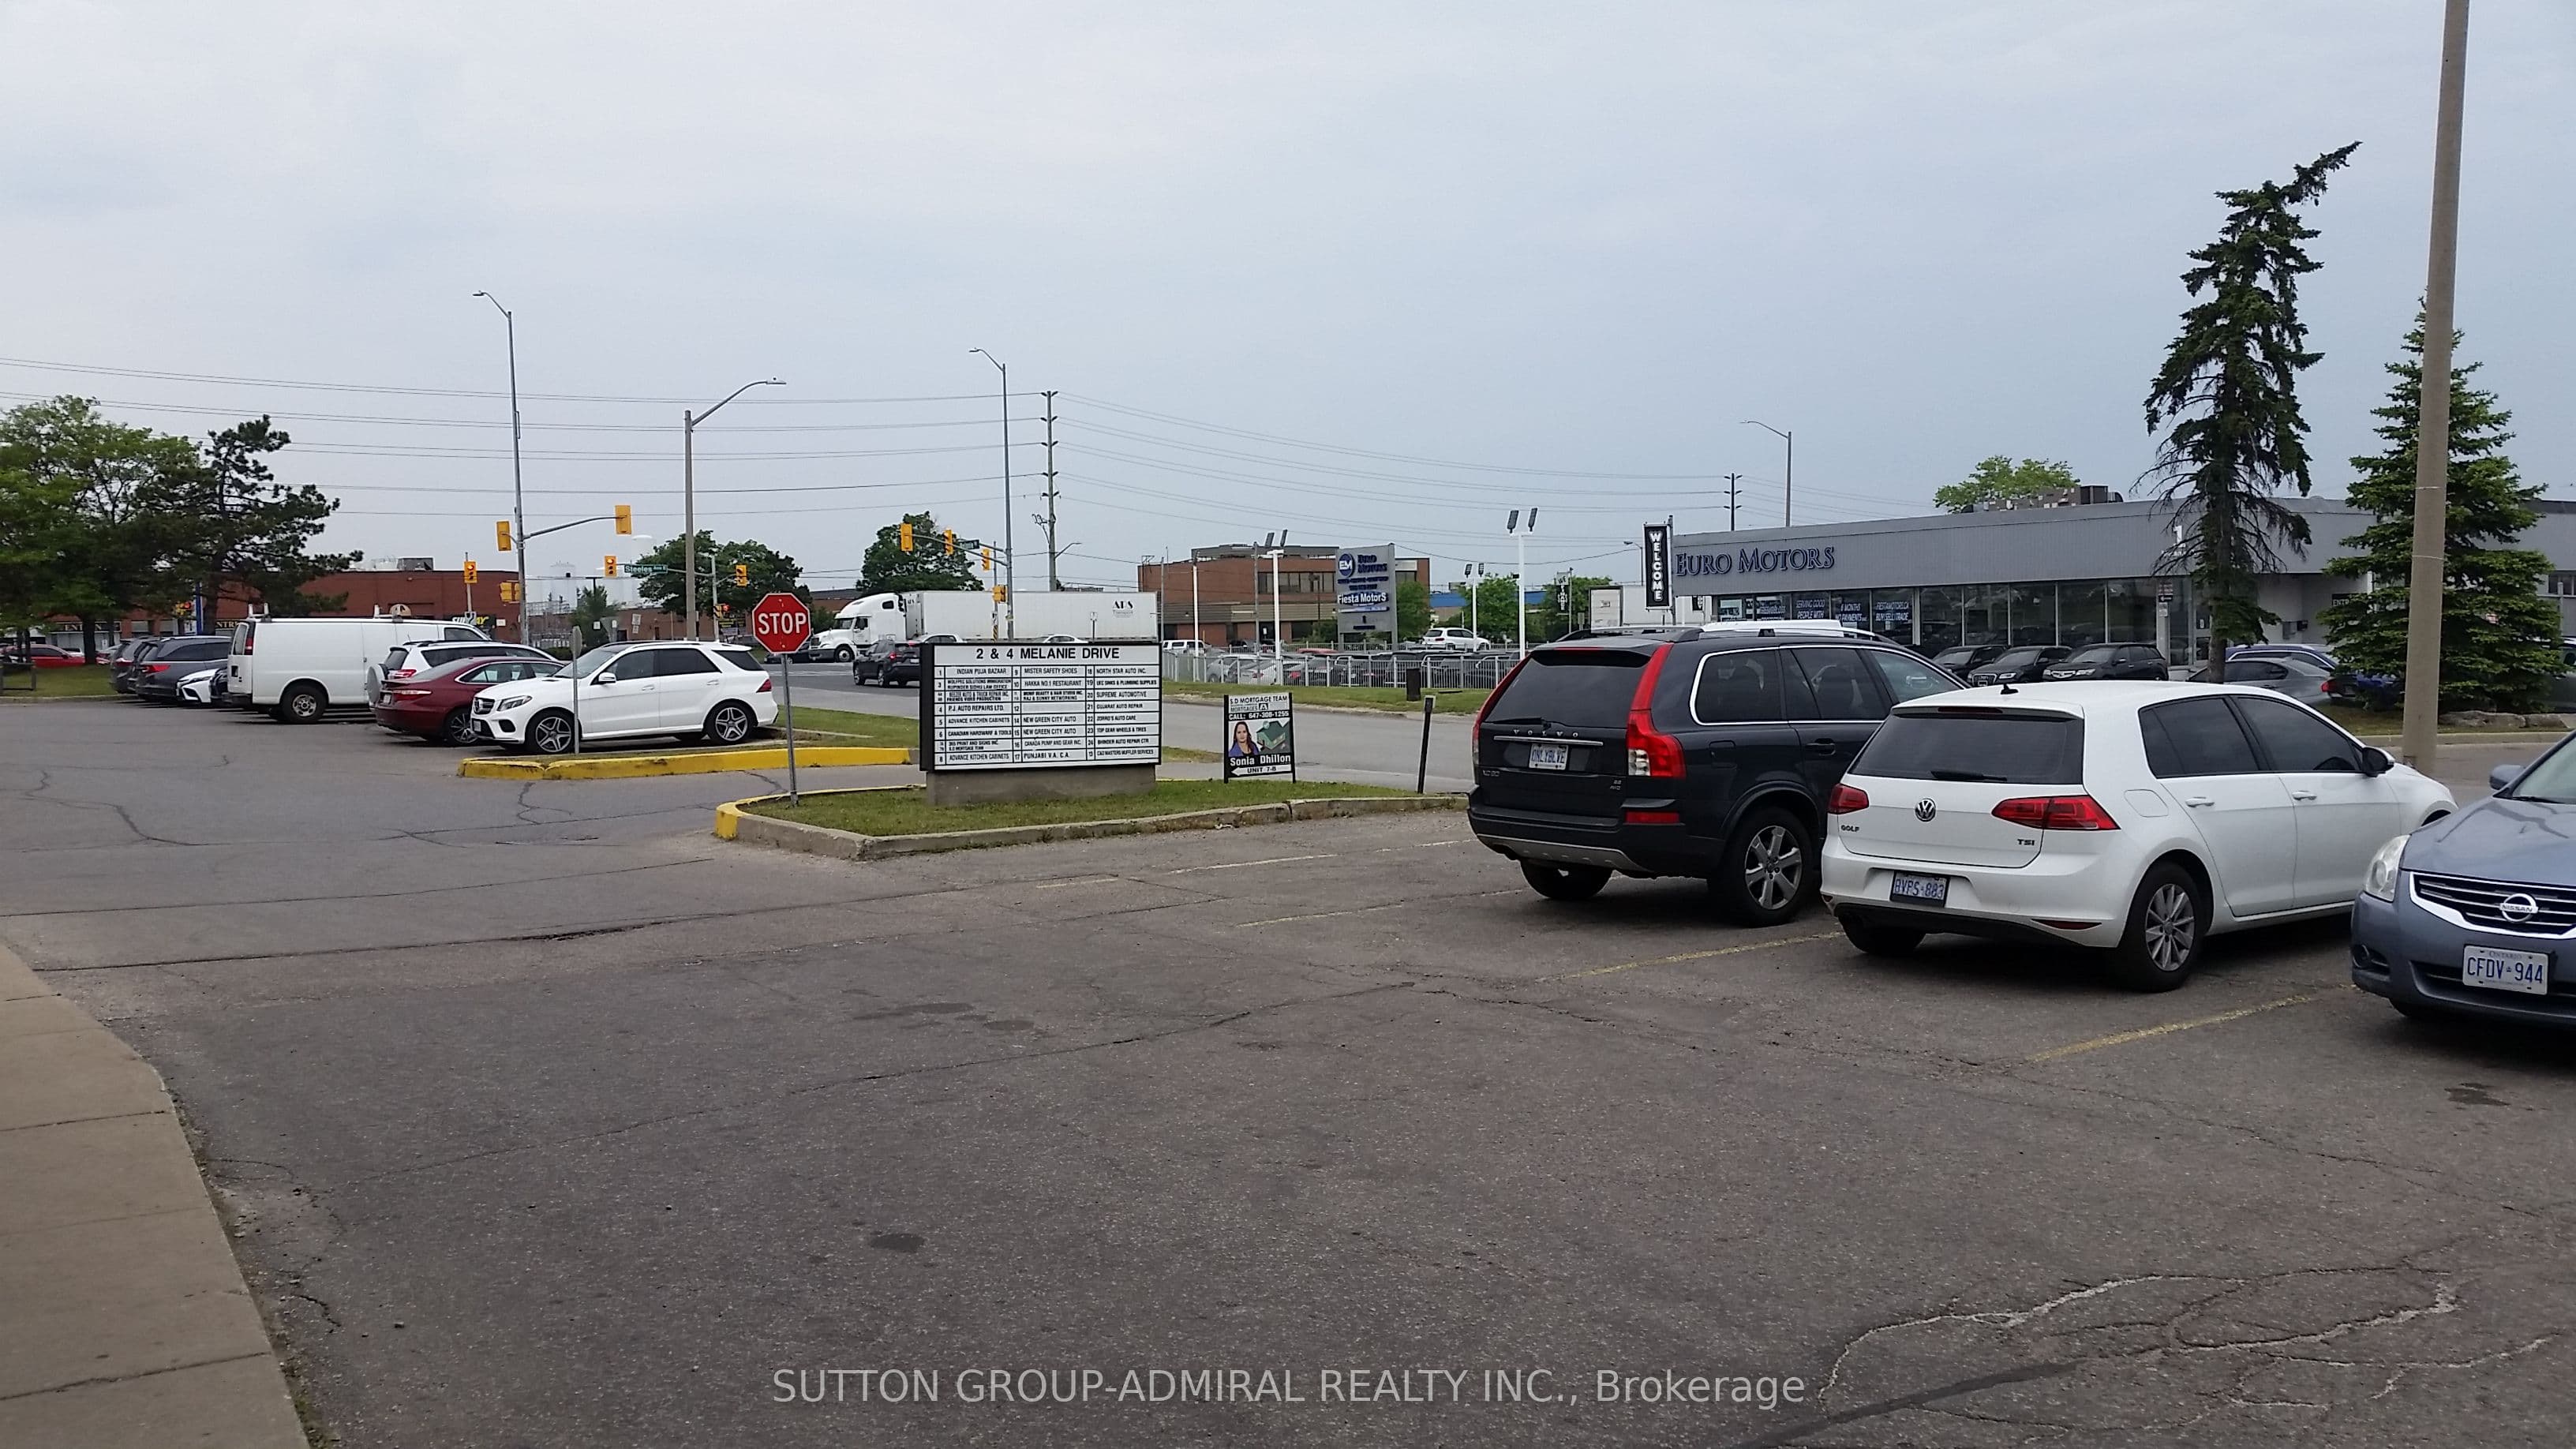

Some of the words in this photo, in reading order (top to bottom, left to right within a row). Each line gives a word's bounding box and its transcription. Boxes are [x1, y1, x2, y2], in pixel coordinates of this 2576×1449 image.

[1649, 532, 1663, 601] WELCOME
[1337, 594, 1359, 604] Fiesta
[758, 612, 807, 635] STOP
[976, 648, 984, 659] 2
[990, 648, 999, 660] &
[1006, 648, 1014, 659] 4
[1020, 647, 1076, 659] MELANIE
[1082, 647, 1120, 658] DRIVE
[1230, 755, 1255, 766] Sonia
[1260, 754, 1291, 765] Dhillon
